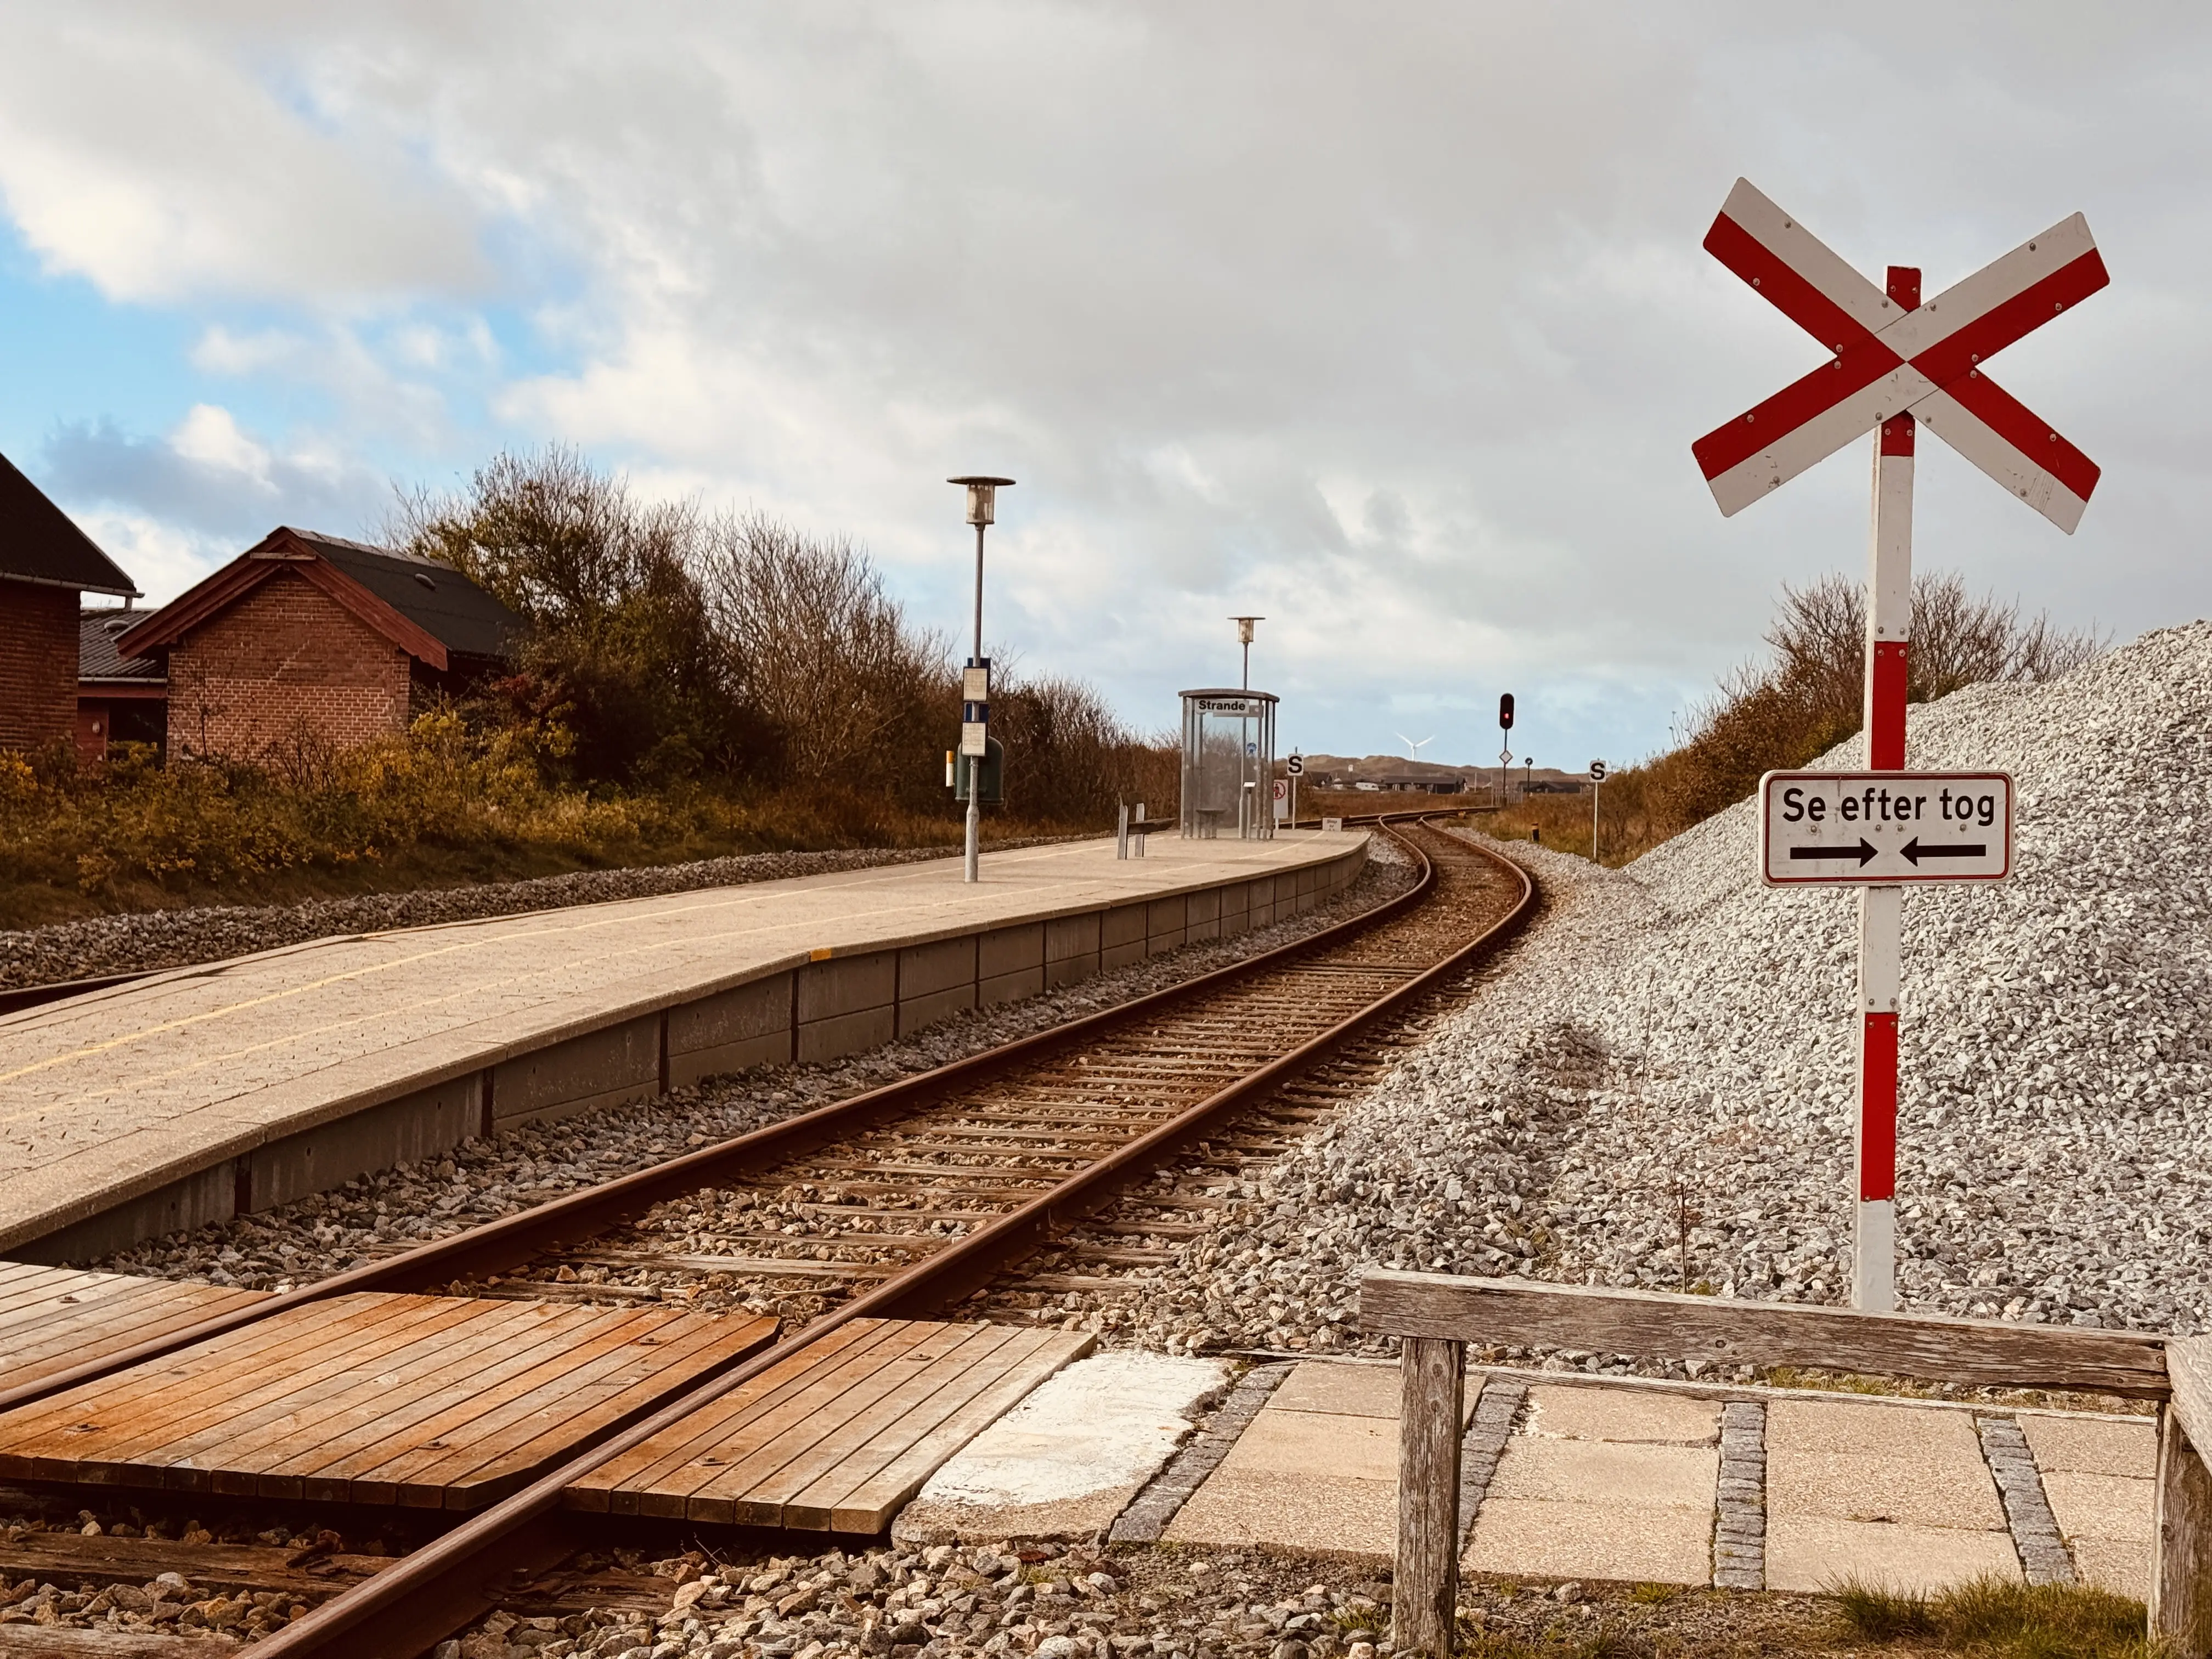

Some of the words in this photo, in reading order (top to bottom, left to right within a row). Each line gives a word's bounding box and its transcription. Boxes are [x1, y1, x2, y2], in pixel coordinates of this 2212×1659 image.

[1199, 700, 1245, 710] Strande
[1288, 756, 1302, 773] S
[1591, 763, 1605, 780] S
[1782, 788, 1826, 822] Se
[1841, 787, 1927, 821] efter
[1939, 788, 1995, 826] tog
